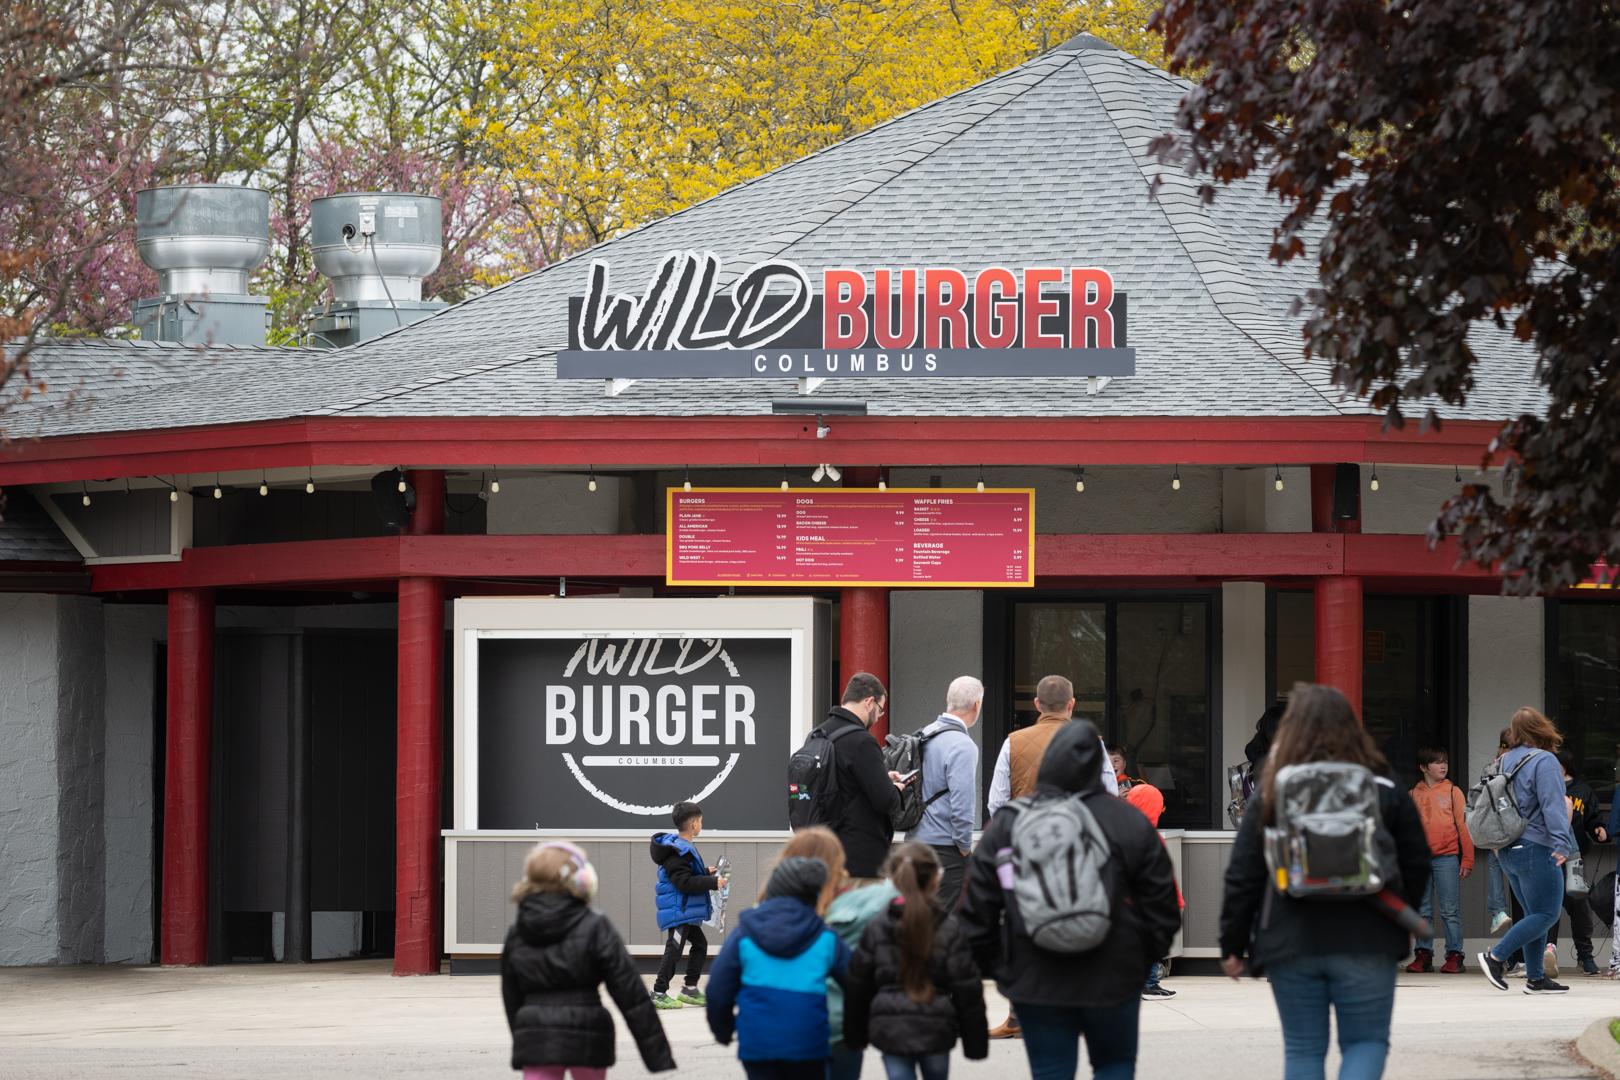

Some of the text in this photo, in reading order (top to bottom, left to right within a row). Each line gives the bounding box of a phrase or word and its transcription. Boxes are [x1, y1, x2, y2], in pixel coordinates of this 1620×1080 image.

[578, 249, 1116, 350] WILD BURGER
[754, 354, 938, 371] COLUMBUS
[586, 638, 723, 676] WILD
[546, 684, 756, 745] BURGER
[618, 757, 685, 765] COLUMBUS
